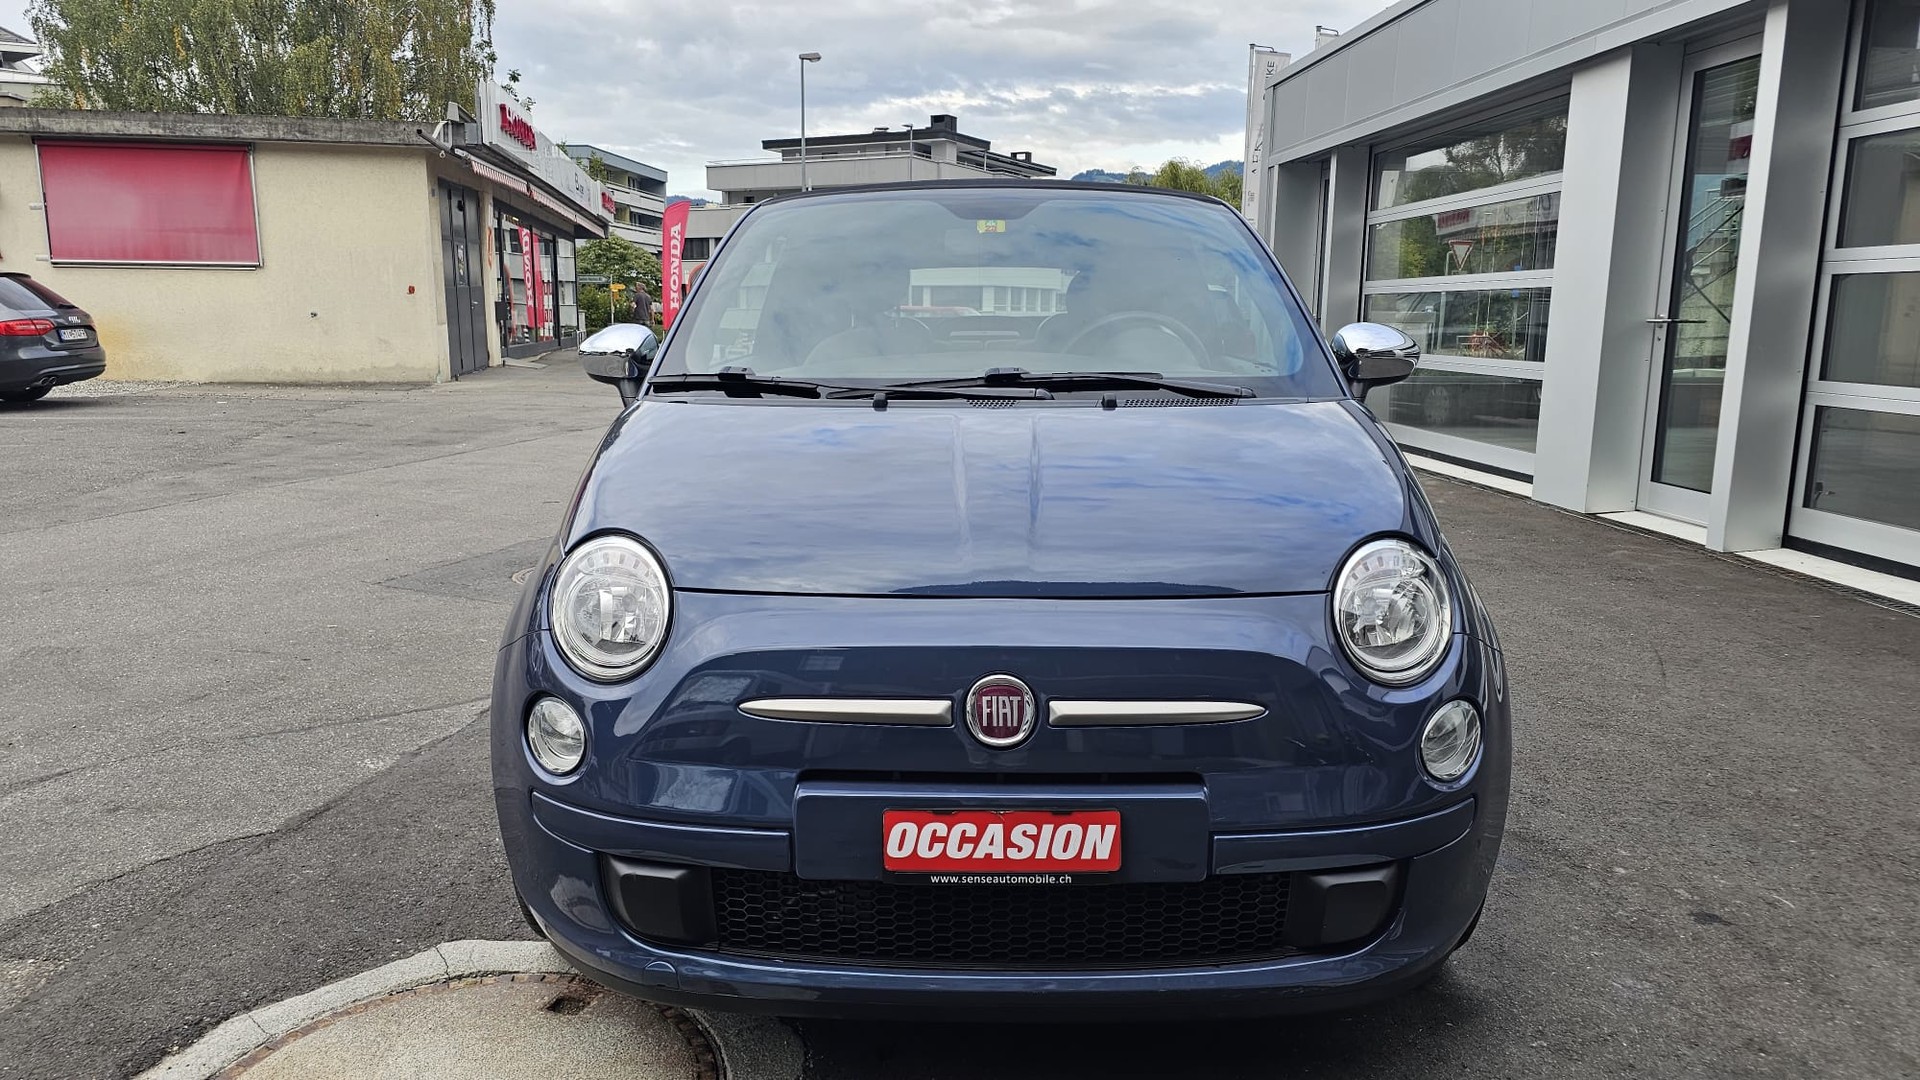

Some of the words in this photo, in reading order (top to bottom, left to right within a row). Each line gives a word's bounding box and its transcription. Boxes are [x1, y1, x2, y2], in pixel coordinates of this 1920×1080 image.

[670, 223, 682, 310] HONDA
[982, 695, 1022, 727] FIAT
[886, 821, 1117, 861] OCCASION
[930, 873, 1072, 885] www.senseautomobile.ch
